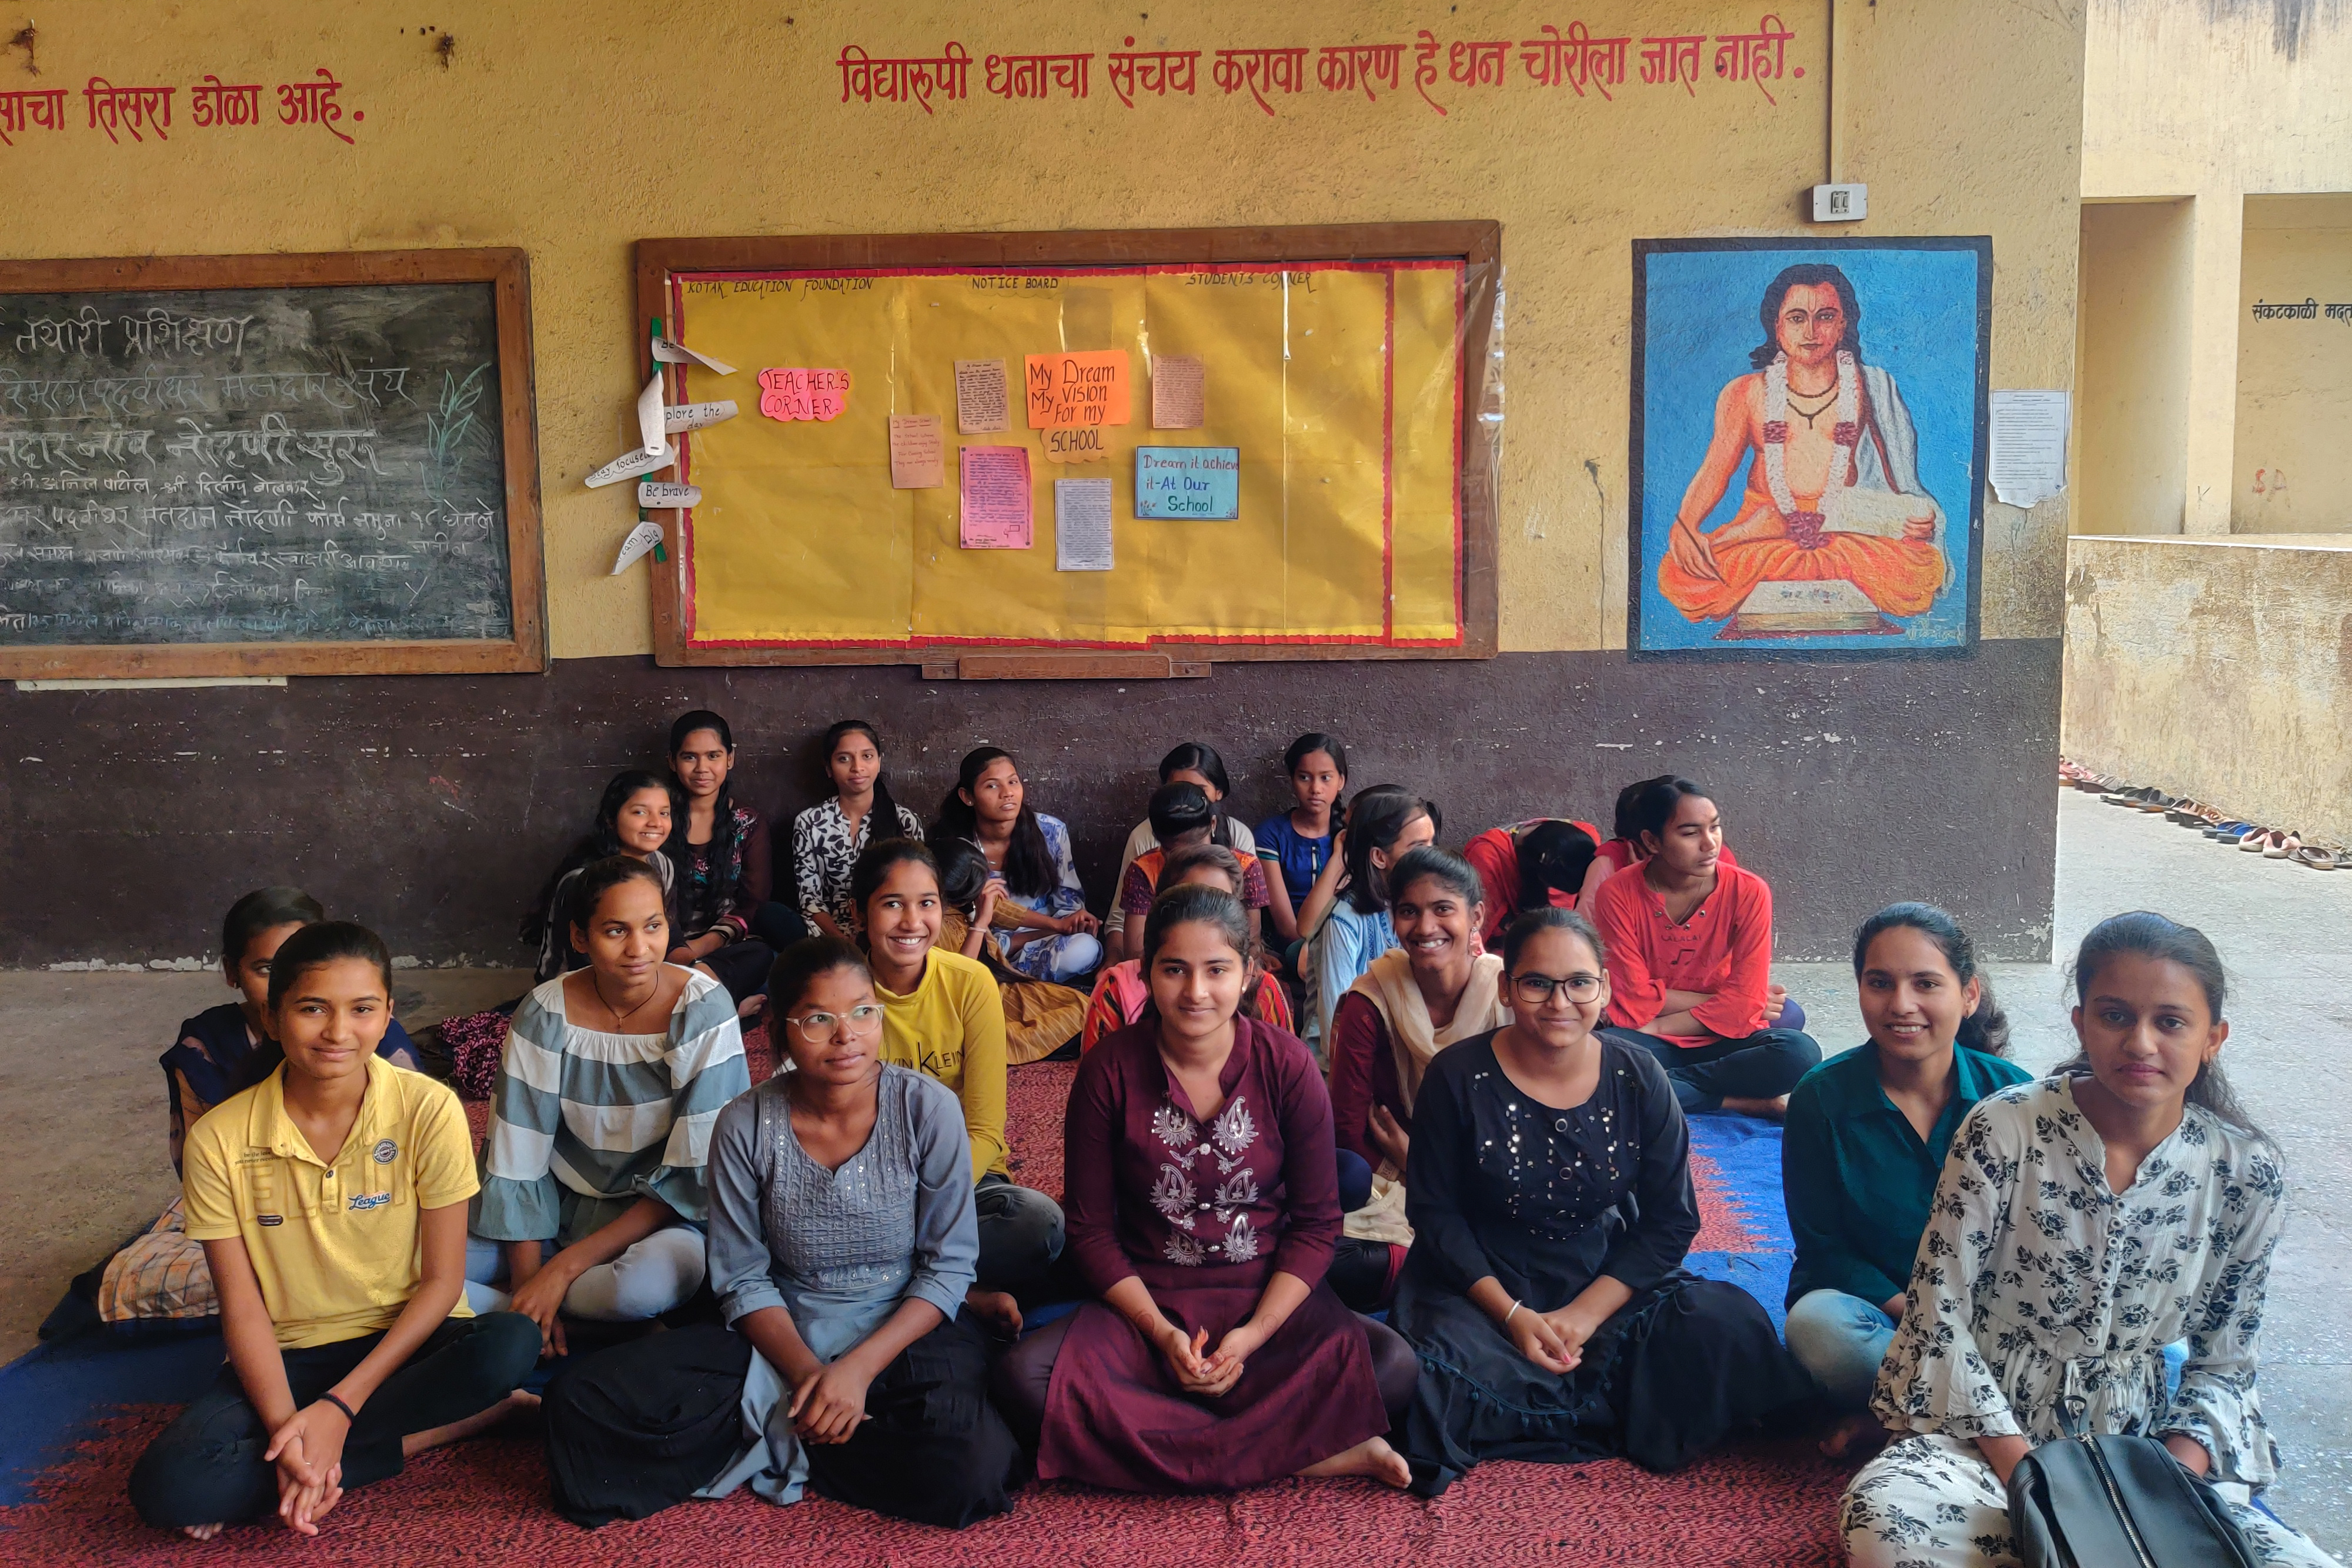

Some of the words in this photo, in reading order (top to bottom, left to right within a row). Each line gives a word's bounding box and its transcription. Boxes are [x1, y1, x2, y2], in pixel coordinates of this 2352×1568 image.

[836, 42, 973, 115] विद्यारूपी
[984, 53, 1095, 99] धनाचा
[1108, 36, 1201, 109] संचय
[1215, 48, 1309, 116] करावा
[1317, 44, 1407, 102] कारण
[1414, 30, 1447, 115] हे
[1449, 41, 1512, 87] धन
[1521, 20, 1631, 101] चोरीला
[1641, 35, 1707, 97] जात
[1715, 15, 1805, 106] नाही.
[83, 76, 176, 144] तिसरा
[192, 75, 263, 126] डोळा
[277, 68, 365, 145] आहे.
[687, 282, 728, 299] KOTAK
[734, 279, 793, 300] EDUCATION
[800, 278, 874, 302] FOUNDATION
[971, 276, 1019, 289] NOTICE
[1025, 277, 1058, 289] BOARD
[2252, 297, 2319, 323] संकटकाळी
[760, 369, 849, 395] TEACHER'S
[1030, 363, 1052, 390] My
[1062, 359, 1115, 384] Dream
[704, 404, 721, 417] the
[1032, 391, 1054, 415] My
[1084, 405, 1105, 426] my
[1050, 429, 1104, 453] SCHOOL
[1144, 455, 1186, 469] Dream
[646, 484, 659, 497] Be
[662, 483, 689, 497] brave
[1184, 477, 1210, 490] Our
[1168, 496, 1212, 512] School
[639, 530, 660, 544] big
[916, 1042, 964, 1077] KLEIN
[348, 1193, 390, 1210] League
